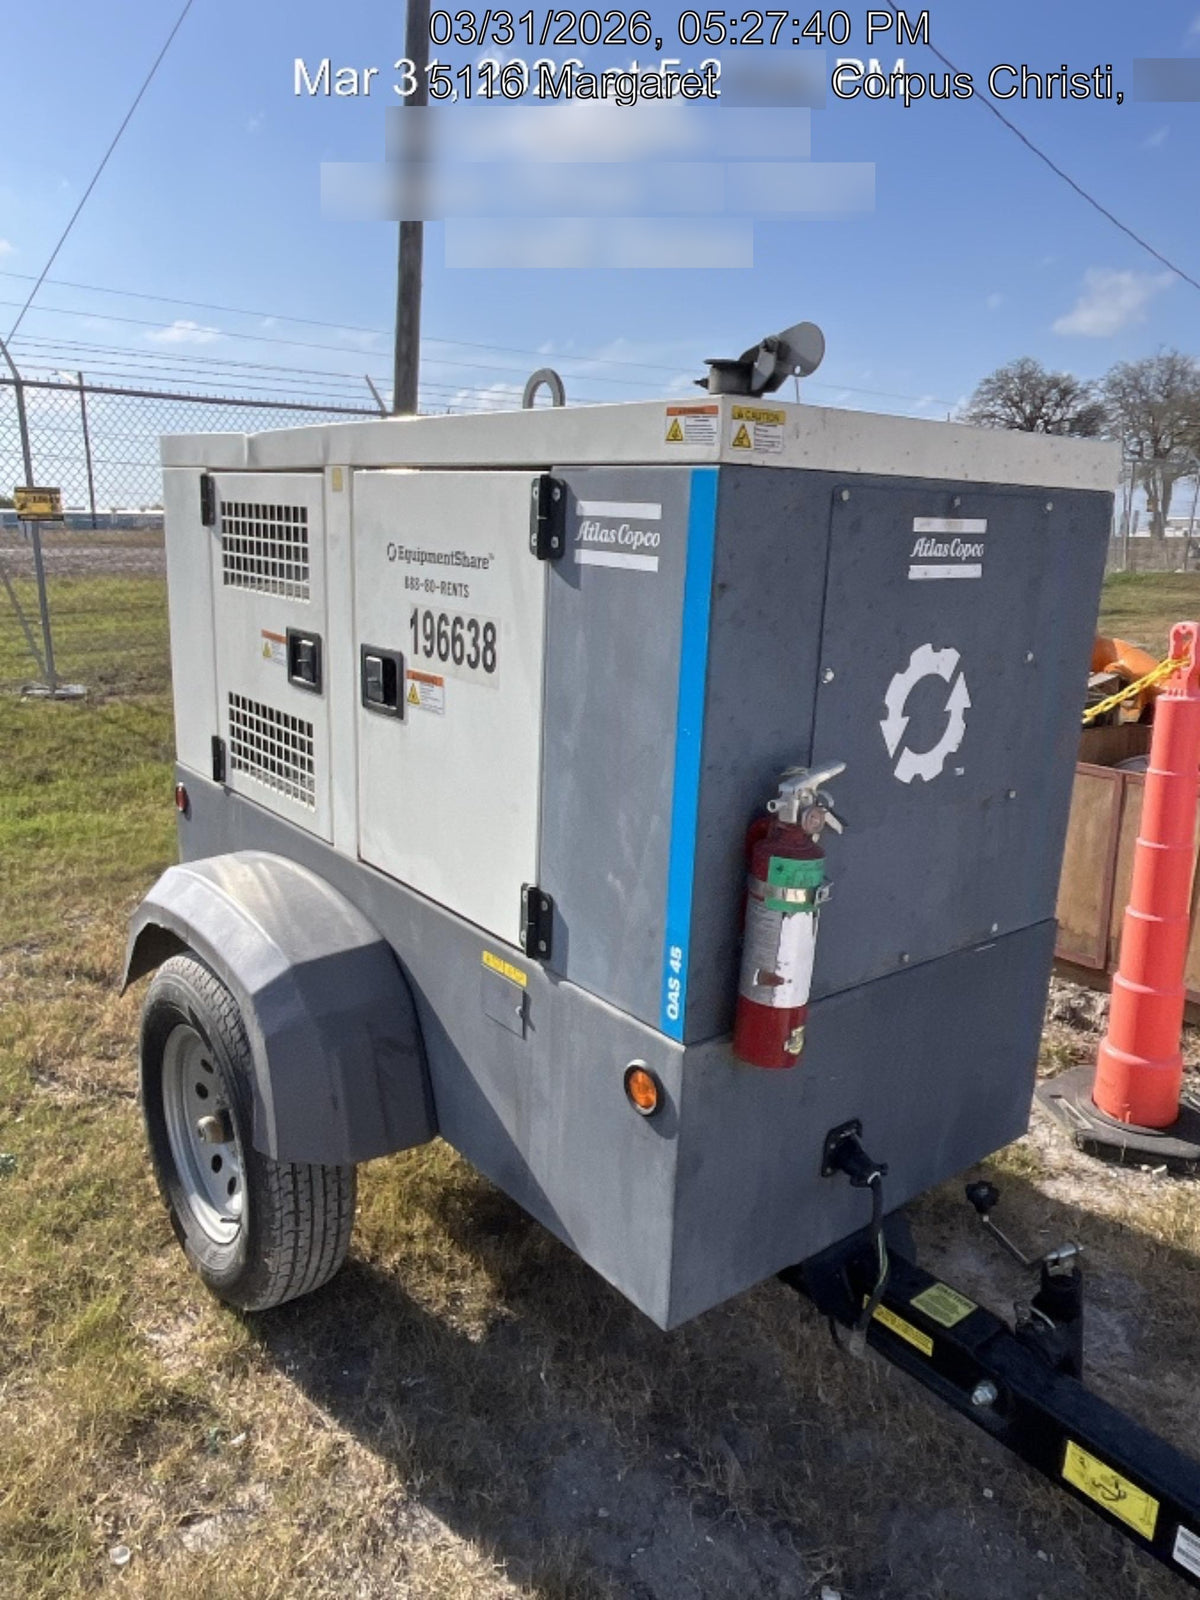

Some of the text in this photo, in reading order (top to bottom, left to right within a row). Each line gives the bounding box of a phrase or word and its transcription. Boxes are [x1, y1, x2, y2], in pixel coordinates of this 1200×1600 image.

[410, 607, 497, 674] 196638
[666, 945, 682, 1020] QAS 45
